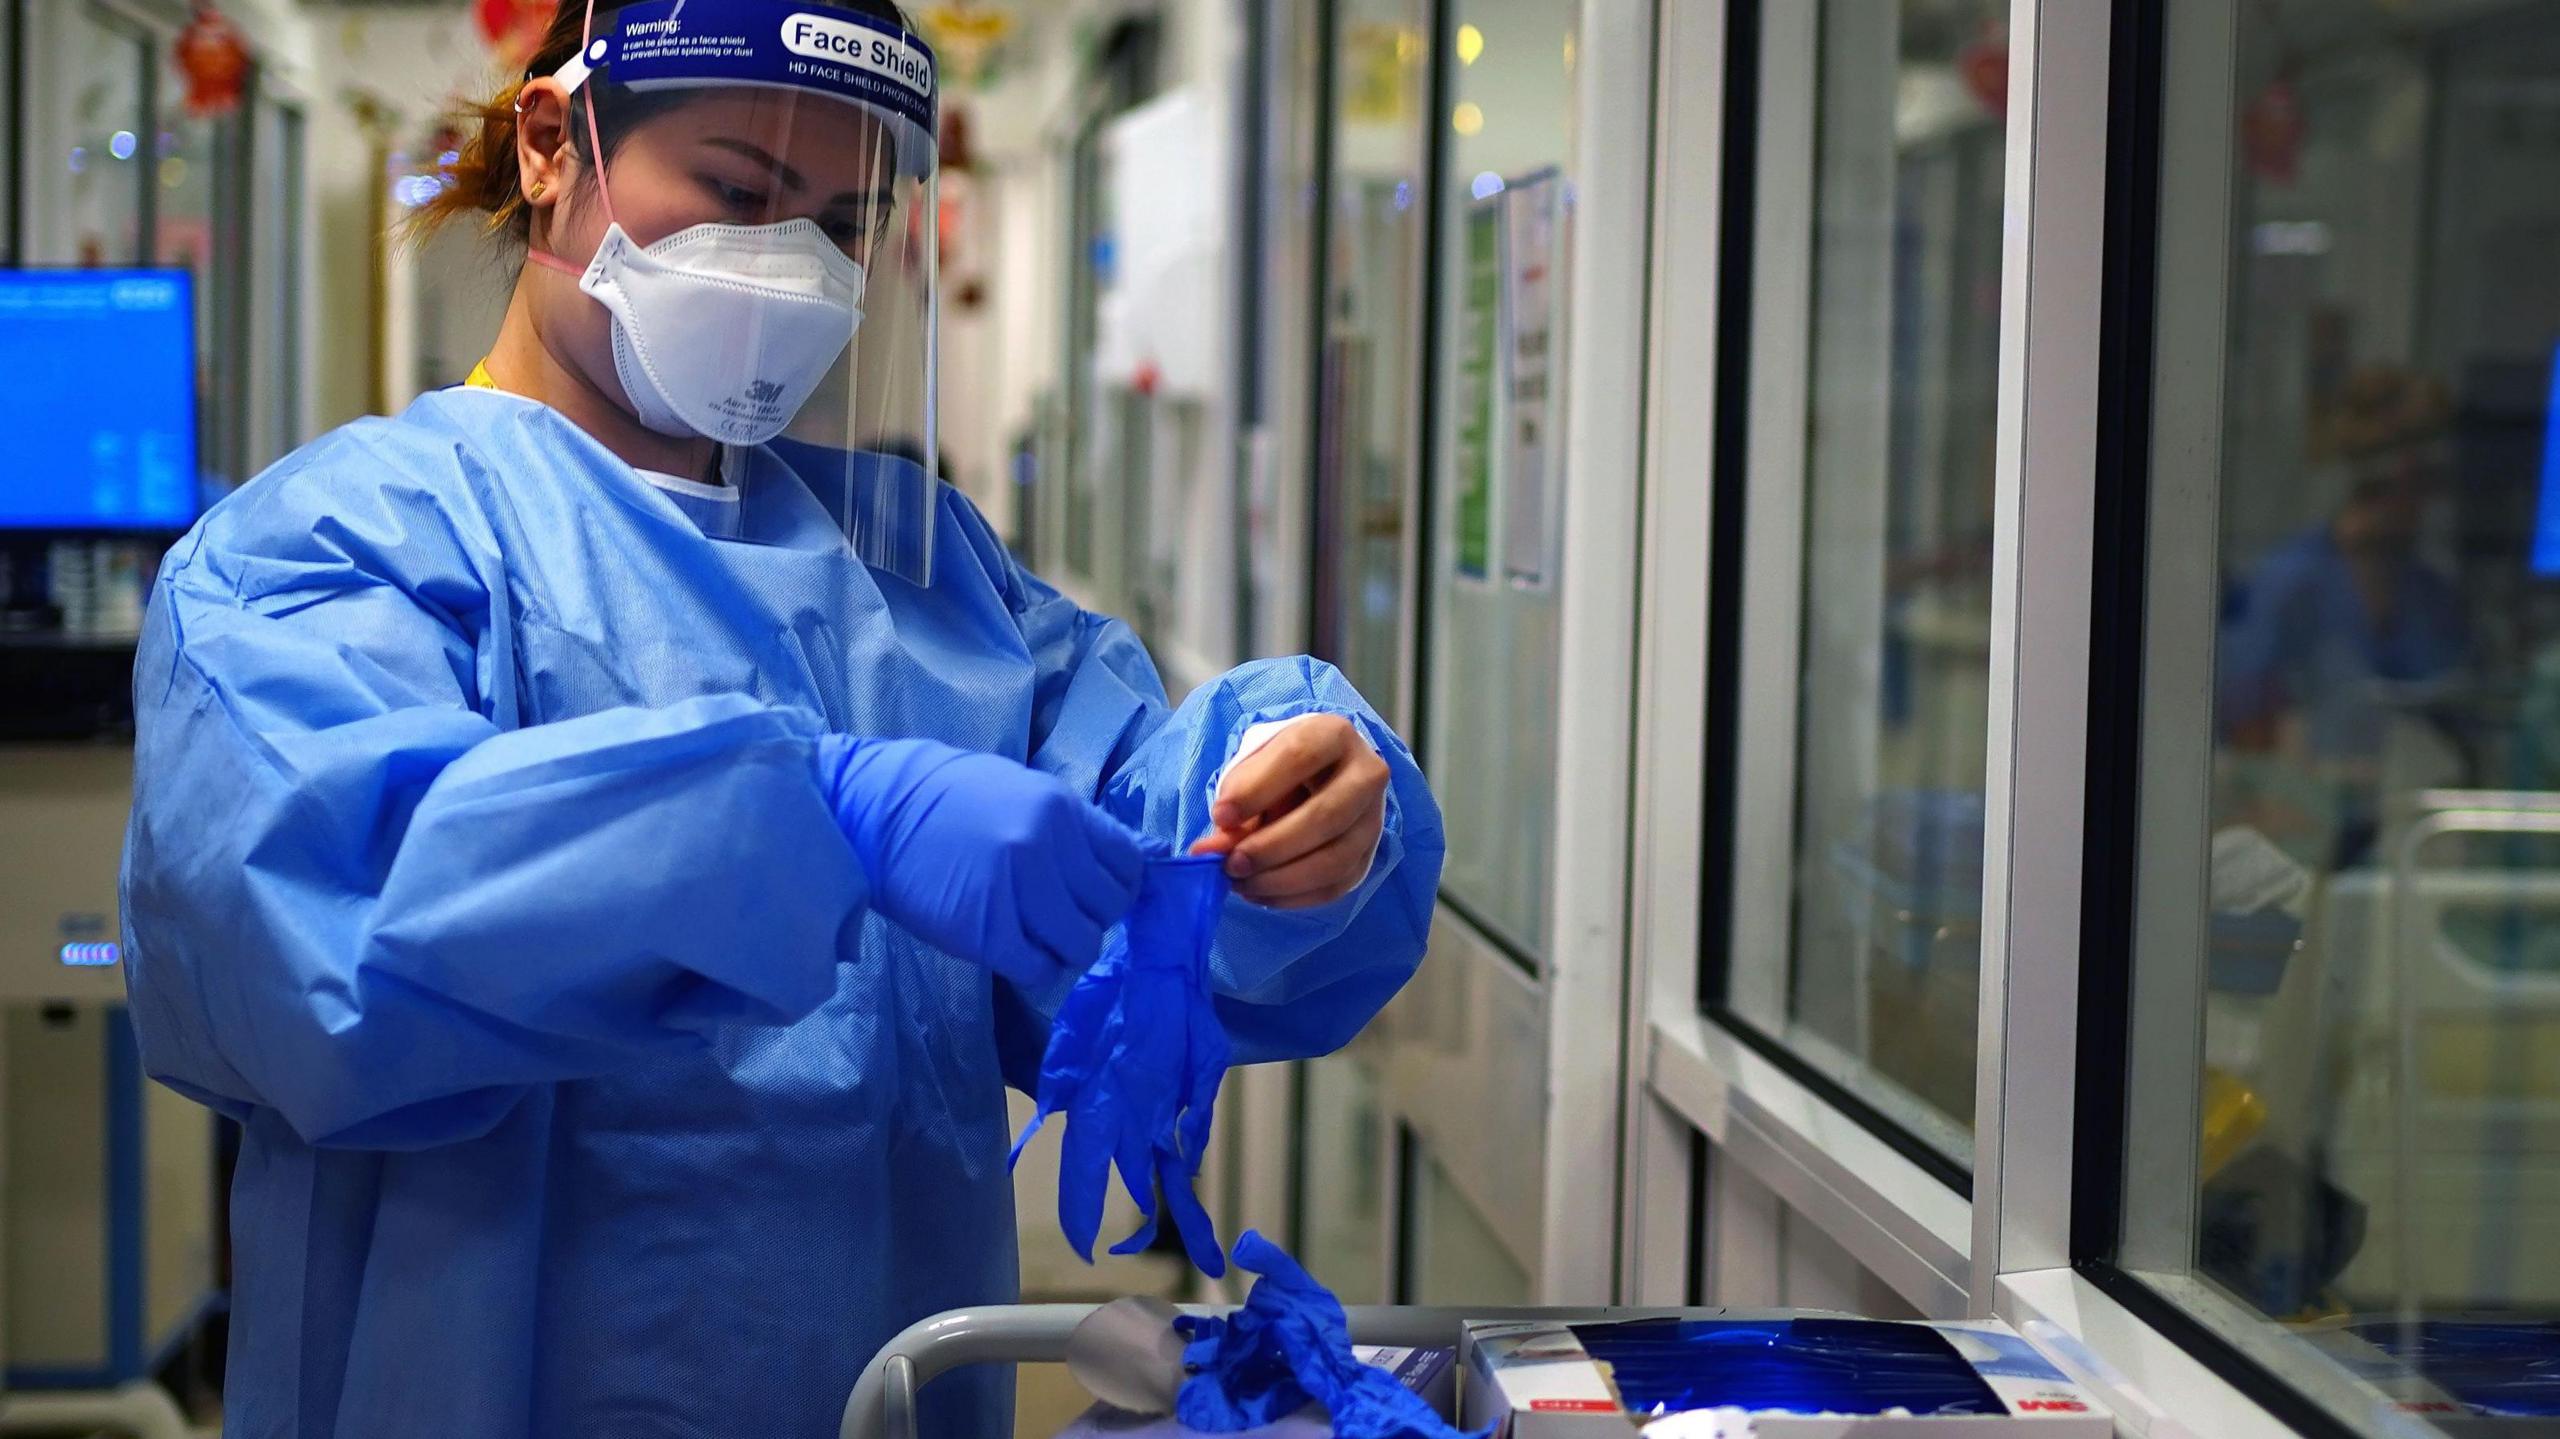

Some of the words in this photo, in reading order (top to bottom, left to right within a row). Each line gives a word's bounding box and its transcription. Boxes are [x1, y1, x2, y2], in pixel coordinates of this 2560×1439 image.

[626, 18, 681, 37] Warning:
[629, 40, 643, 50] can
[645, 38, 656, 48] be
[657, 36, 677, 47] used
[679, 36, 689, 46] as
[691, 37, 697, 45] a
[699, 35, 717, 45] face
[719, 36, 746, 46] shield
[621, 52, 630, 61] to
[630, 48, 660, 61] prevent
[662, 46, 680, 56] fluid
[681, 46, 721, 58] splashing
[723, 48, 732, 56] or
[734, 47, 753, 57] dust
[795, 22, 862, 58] Face
[871, 40, 928, 90] Shield
[789, 61, 807, 74] HD
[810, 64, 841, 81] FACE
[844, 72, 881, 92] SHIELD
[745, 379, 785, 403] 3M
